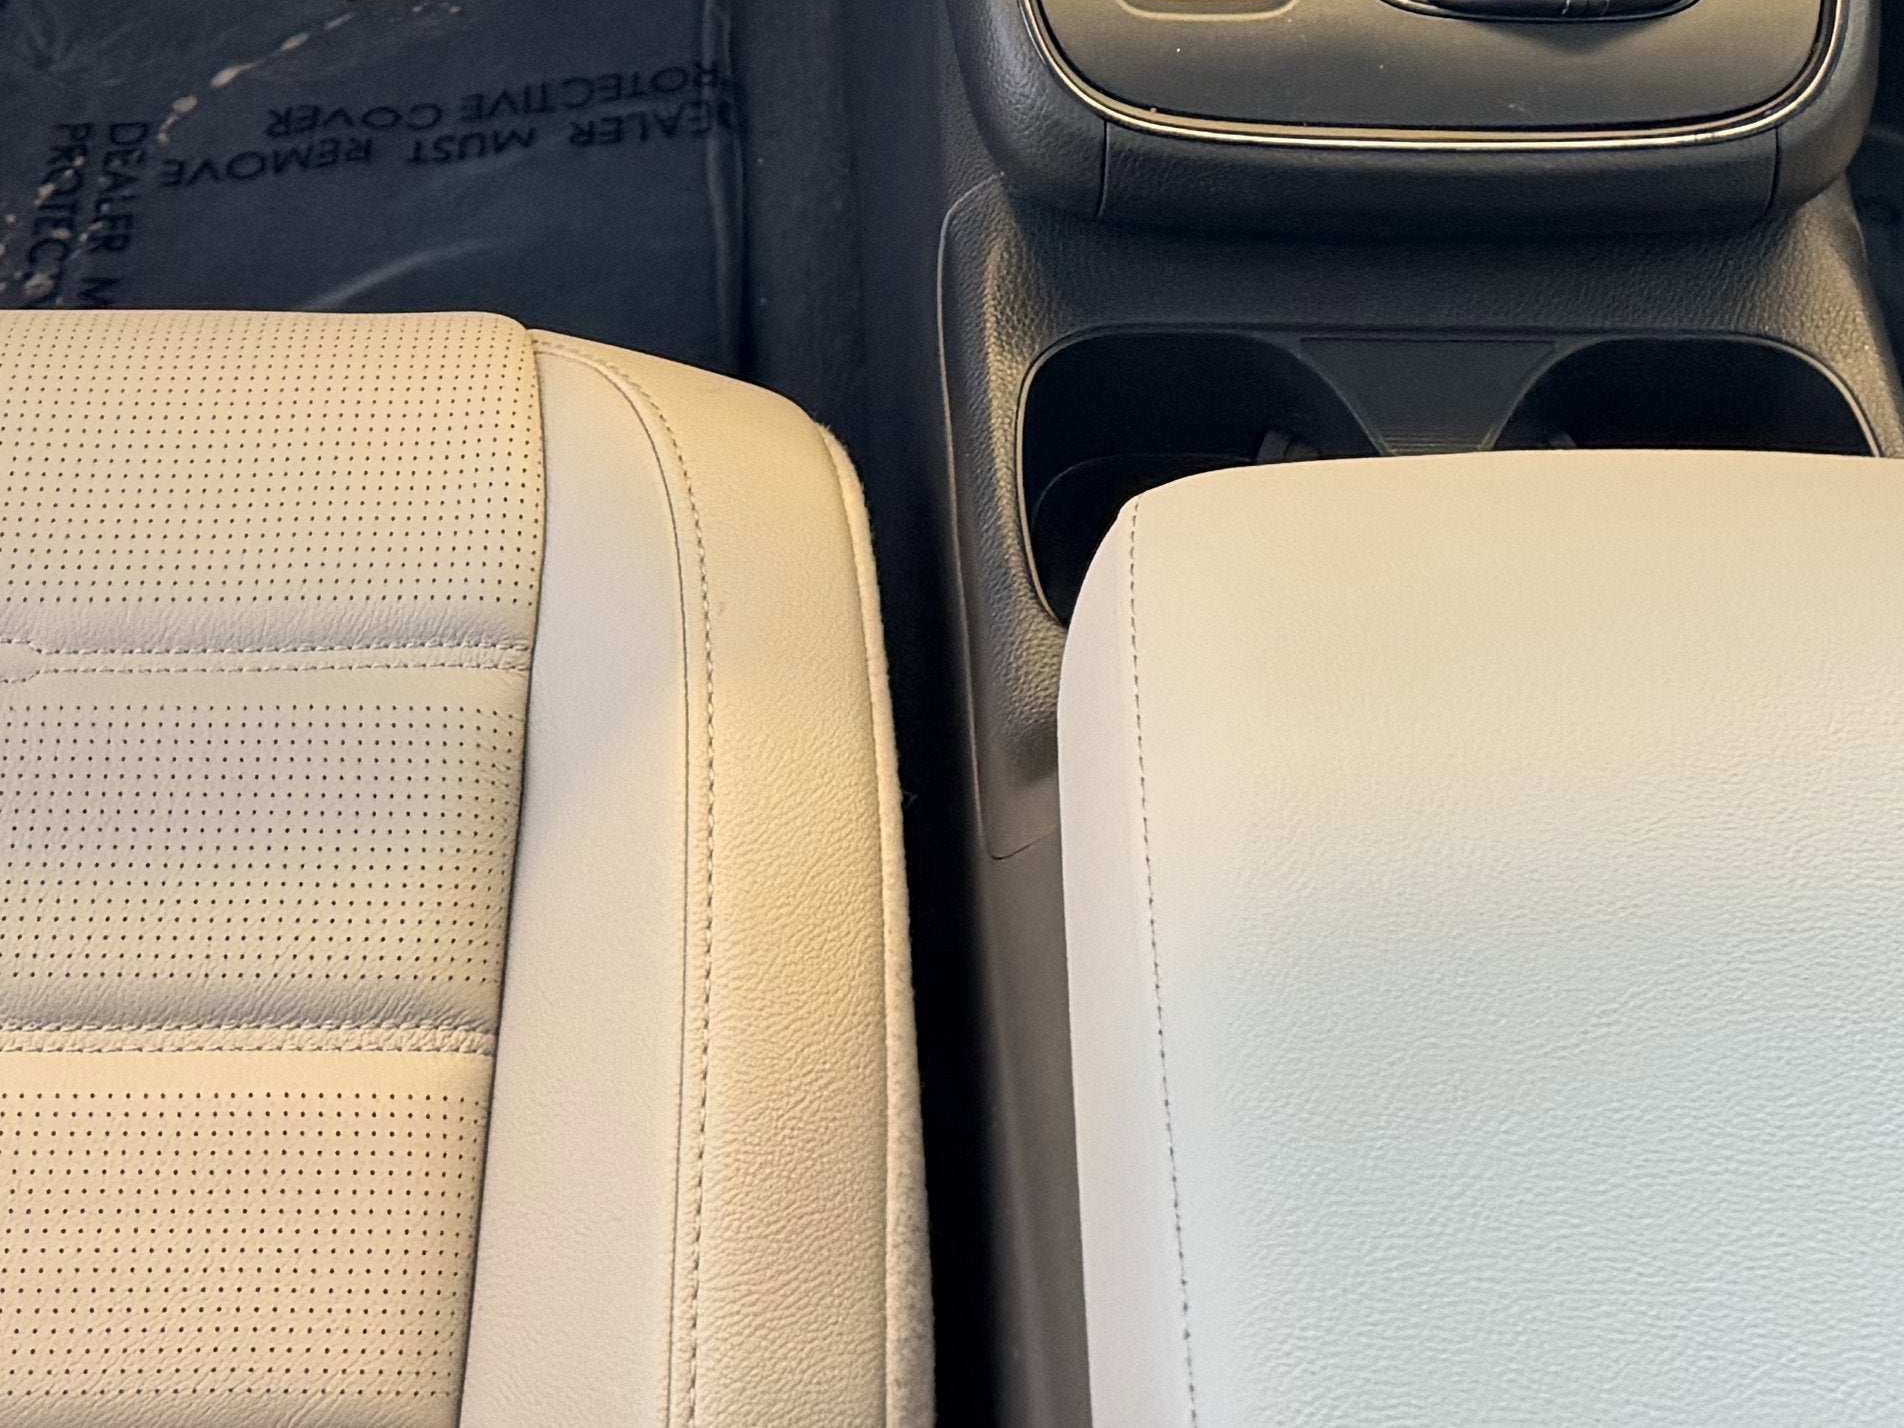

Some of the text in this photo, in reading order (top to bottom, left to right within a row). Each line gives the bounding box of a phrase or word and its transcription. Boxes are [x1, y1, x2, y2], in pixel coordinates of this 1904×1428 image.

[264, 62, 736, 140] ROTECTIVE COVER
[158, 136, 374, 188] REMOVE
[404, 126, 539, 166] MUST
